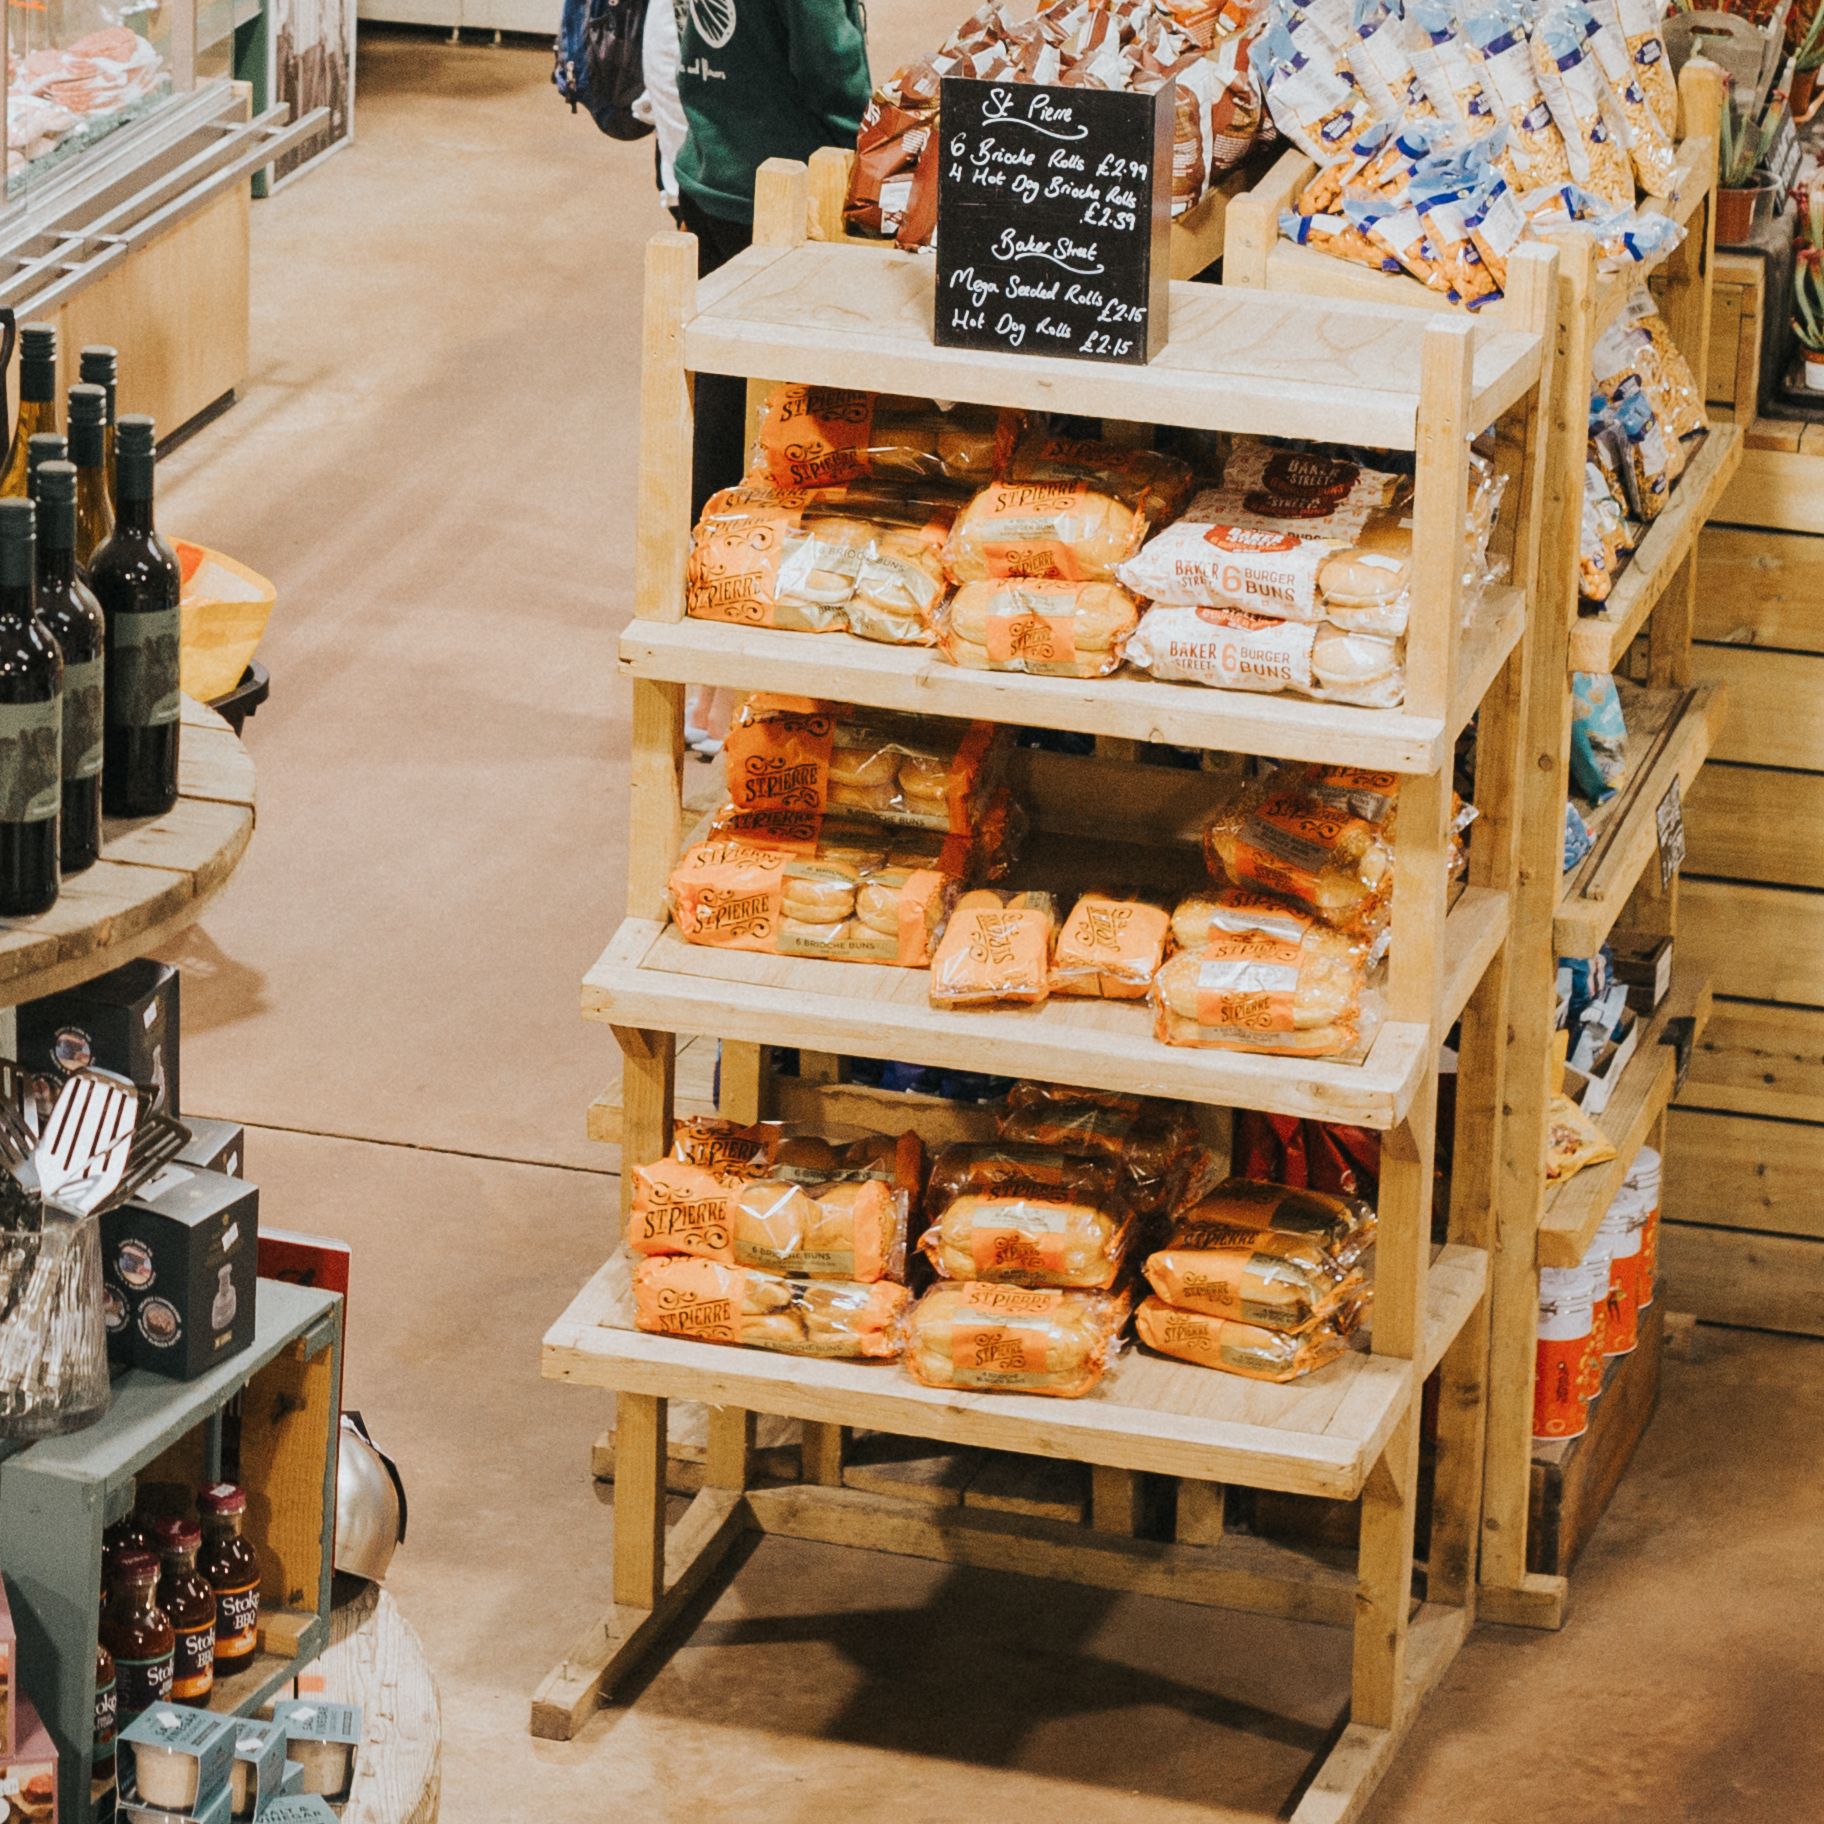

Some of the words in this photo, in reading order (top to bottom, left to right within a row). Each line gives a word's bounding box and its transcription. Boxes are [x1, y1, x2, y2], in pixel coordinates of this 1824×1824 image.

[982, 88, 1013, 118] St
[1027, 94, 1073, 122] Pierre
[950, 132, 966, 157] 6
[970, 137, 1035, 167] Brioche
[1048, 149, 1085, 172] Rolls
[949, 163, 962, 183] 4
[972, 169, 1007, 186] Hot
[1012, 177, 1040, 203] Dog
[1045, 176, 1100, 200] Brioche
[1106, 186, 1137, 210] Rolls
[991, 228, 1051, 260] Baker
[1053, 238, 1098, 262] Street
[950, 267, 1000, 308] Mega
[1006, 276, 1058, 301] Seeded
[1065, 288, 1104, 307] Rolls
[952, 309, 985, 330] Hot
[995, 314, 1026, 347] Dog
[1036, 317, 1071, 339] Rolls
[1222, 565, 1242, 592] 6
[1245, 567, 1296, 586] BURGER
[1245, 581, 1296, 602] BUNS
[1169, 640, 1217, 660] BAKER
[1221, 643, 1238, 673] 6
[1240, 646, 1290, 664] BURGER
[1239, 662, 1292, 680] BUNS
[795, 938, 802, 947] 6
[803, 938, 846, 950] BRIOCHE
[849, 939, 876, 950] BUNS
[804, 1252, 832, 1261] BUNS
